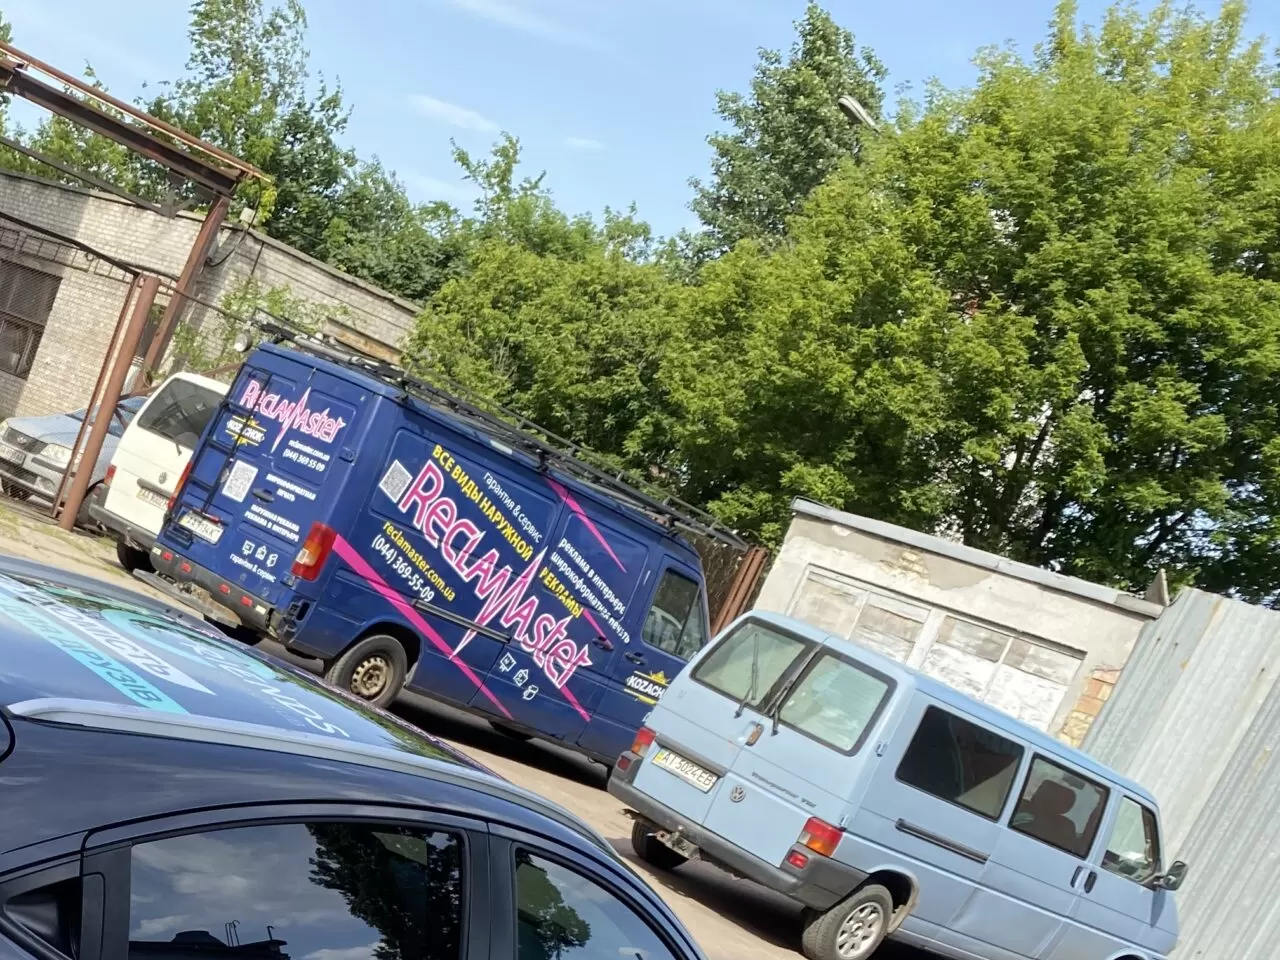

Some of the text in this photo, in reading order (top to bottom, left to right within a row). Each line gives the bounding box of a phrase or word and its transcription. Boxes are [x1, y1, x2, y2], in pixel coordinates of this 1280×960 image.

[227, 419, 265, 442] KOZCHOK
[308, 458, 317, 469] 55
[315, 462, 326, 472] 09
[432, 444, 534, 561] ВСЕ ВИДЫ НАРУЖНОЙ
[483, 472, 543, 544] гарантия & сервис
[371, 534, 435, 602] (044) 369-55-09
[383, 521, 456, 602] reclamaster.com.ua
[539, 567, 585, 619] РЕКЛАМЫ
[558, 537, 590, 574] реклама
[592, 573, 627, 615] интерьере
[626, 675, 667, 699] KOZACH
